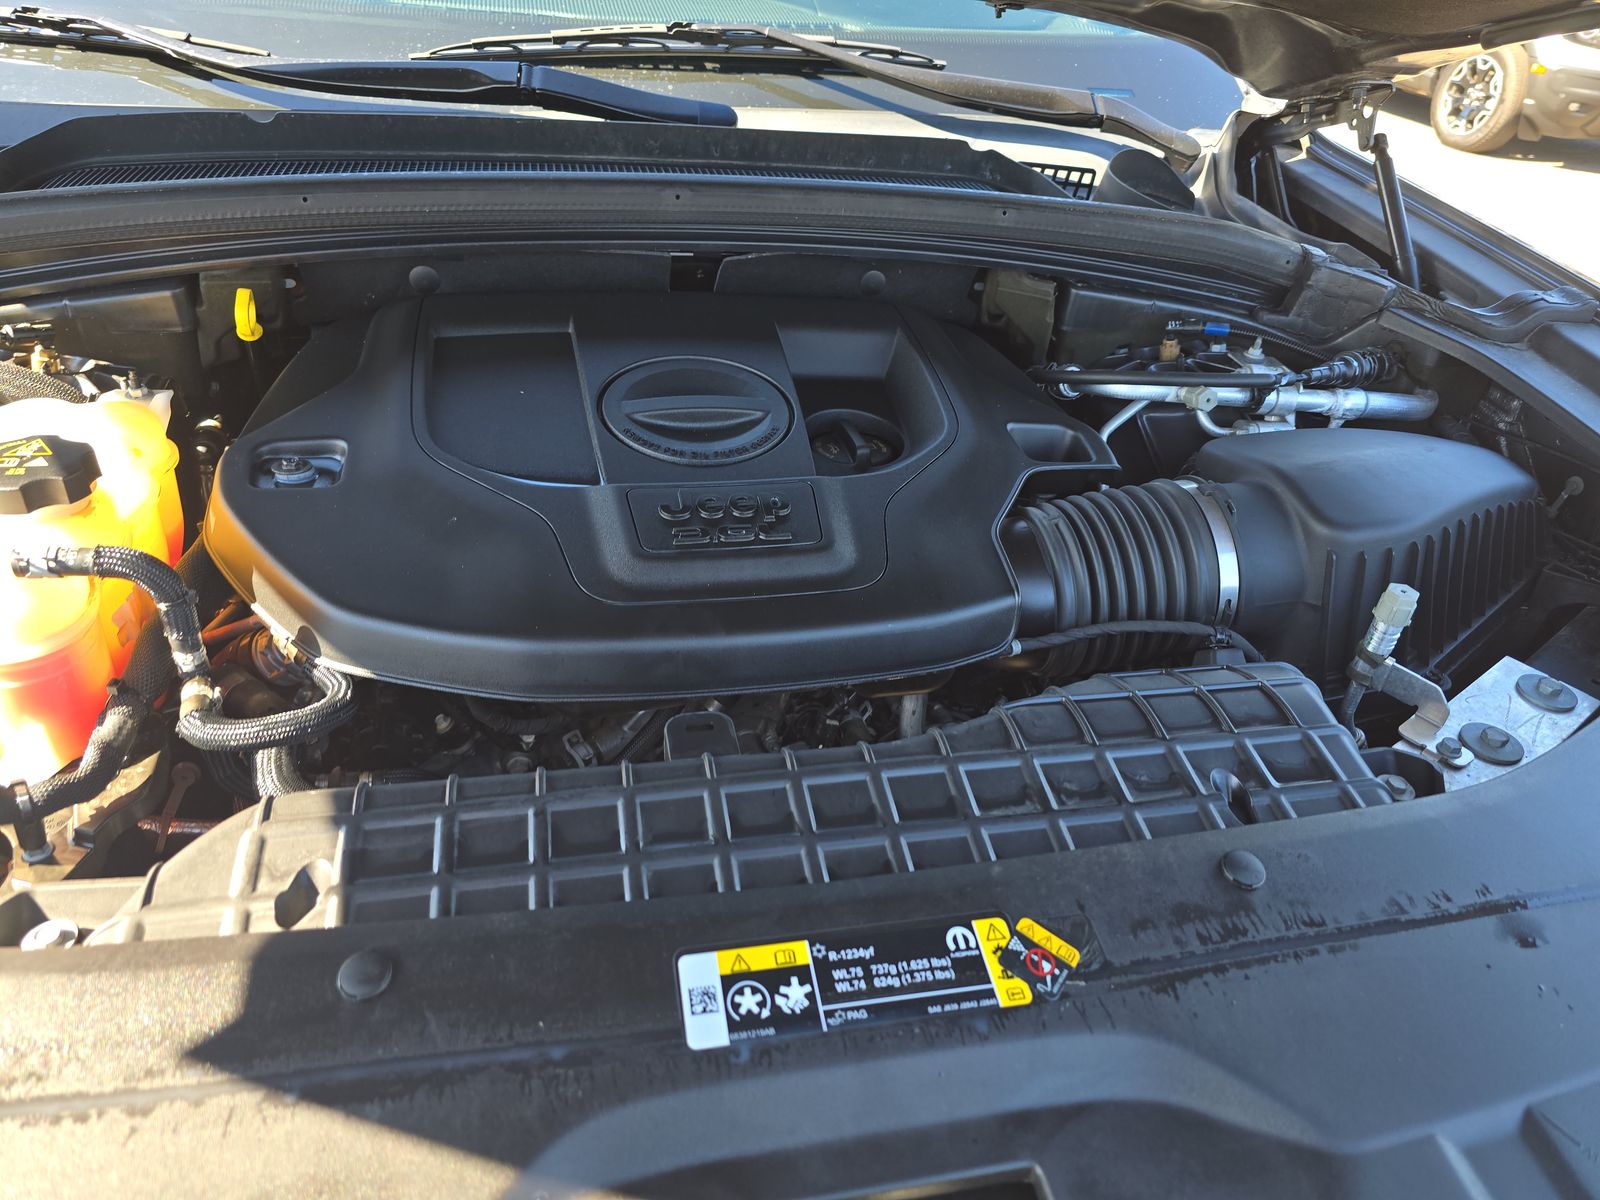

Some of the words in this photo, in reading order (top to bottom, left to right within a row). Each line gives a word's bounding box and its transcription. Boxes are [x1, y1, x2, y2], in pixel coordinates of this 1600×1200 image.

[658, 488, 791, 522] Jeep
[828, 945, 874, 962] R-1234yf
[832, 966, 864, 981] WL75
[870, 963, 897, 976] 737g
[930, 955, 952, 968] lbs)
[834, 978, 867, 993] WL74
[933, 967, 956, 981] lbs)
[846, 1008, 868, 1021] PAG
